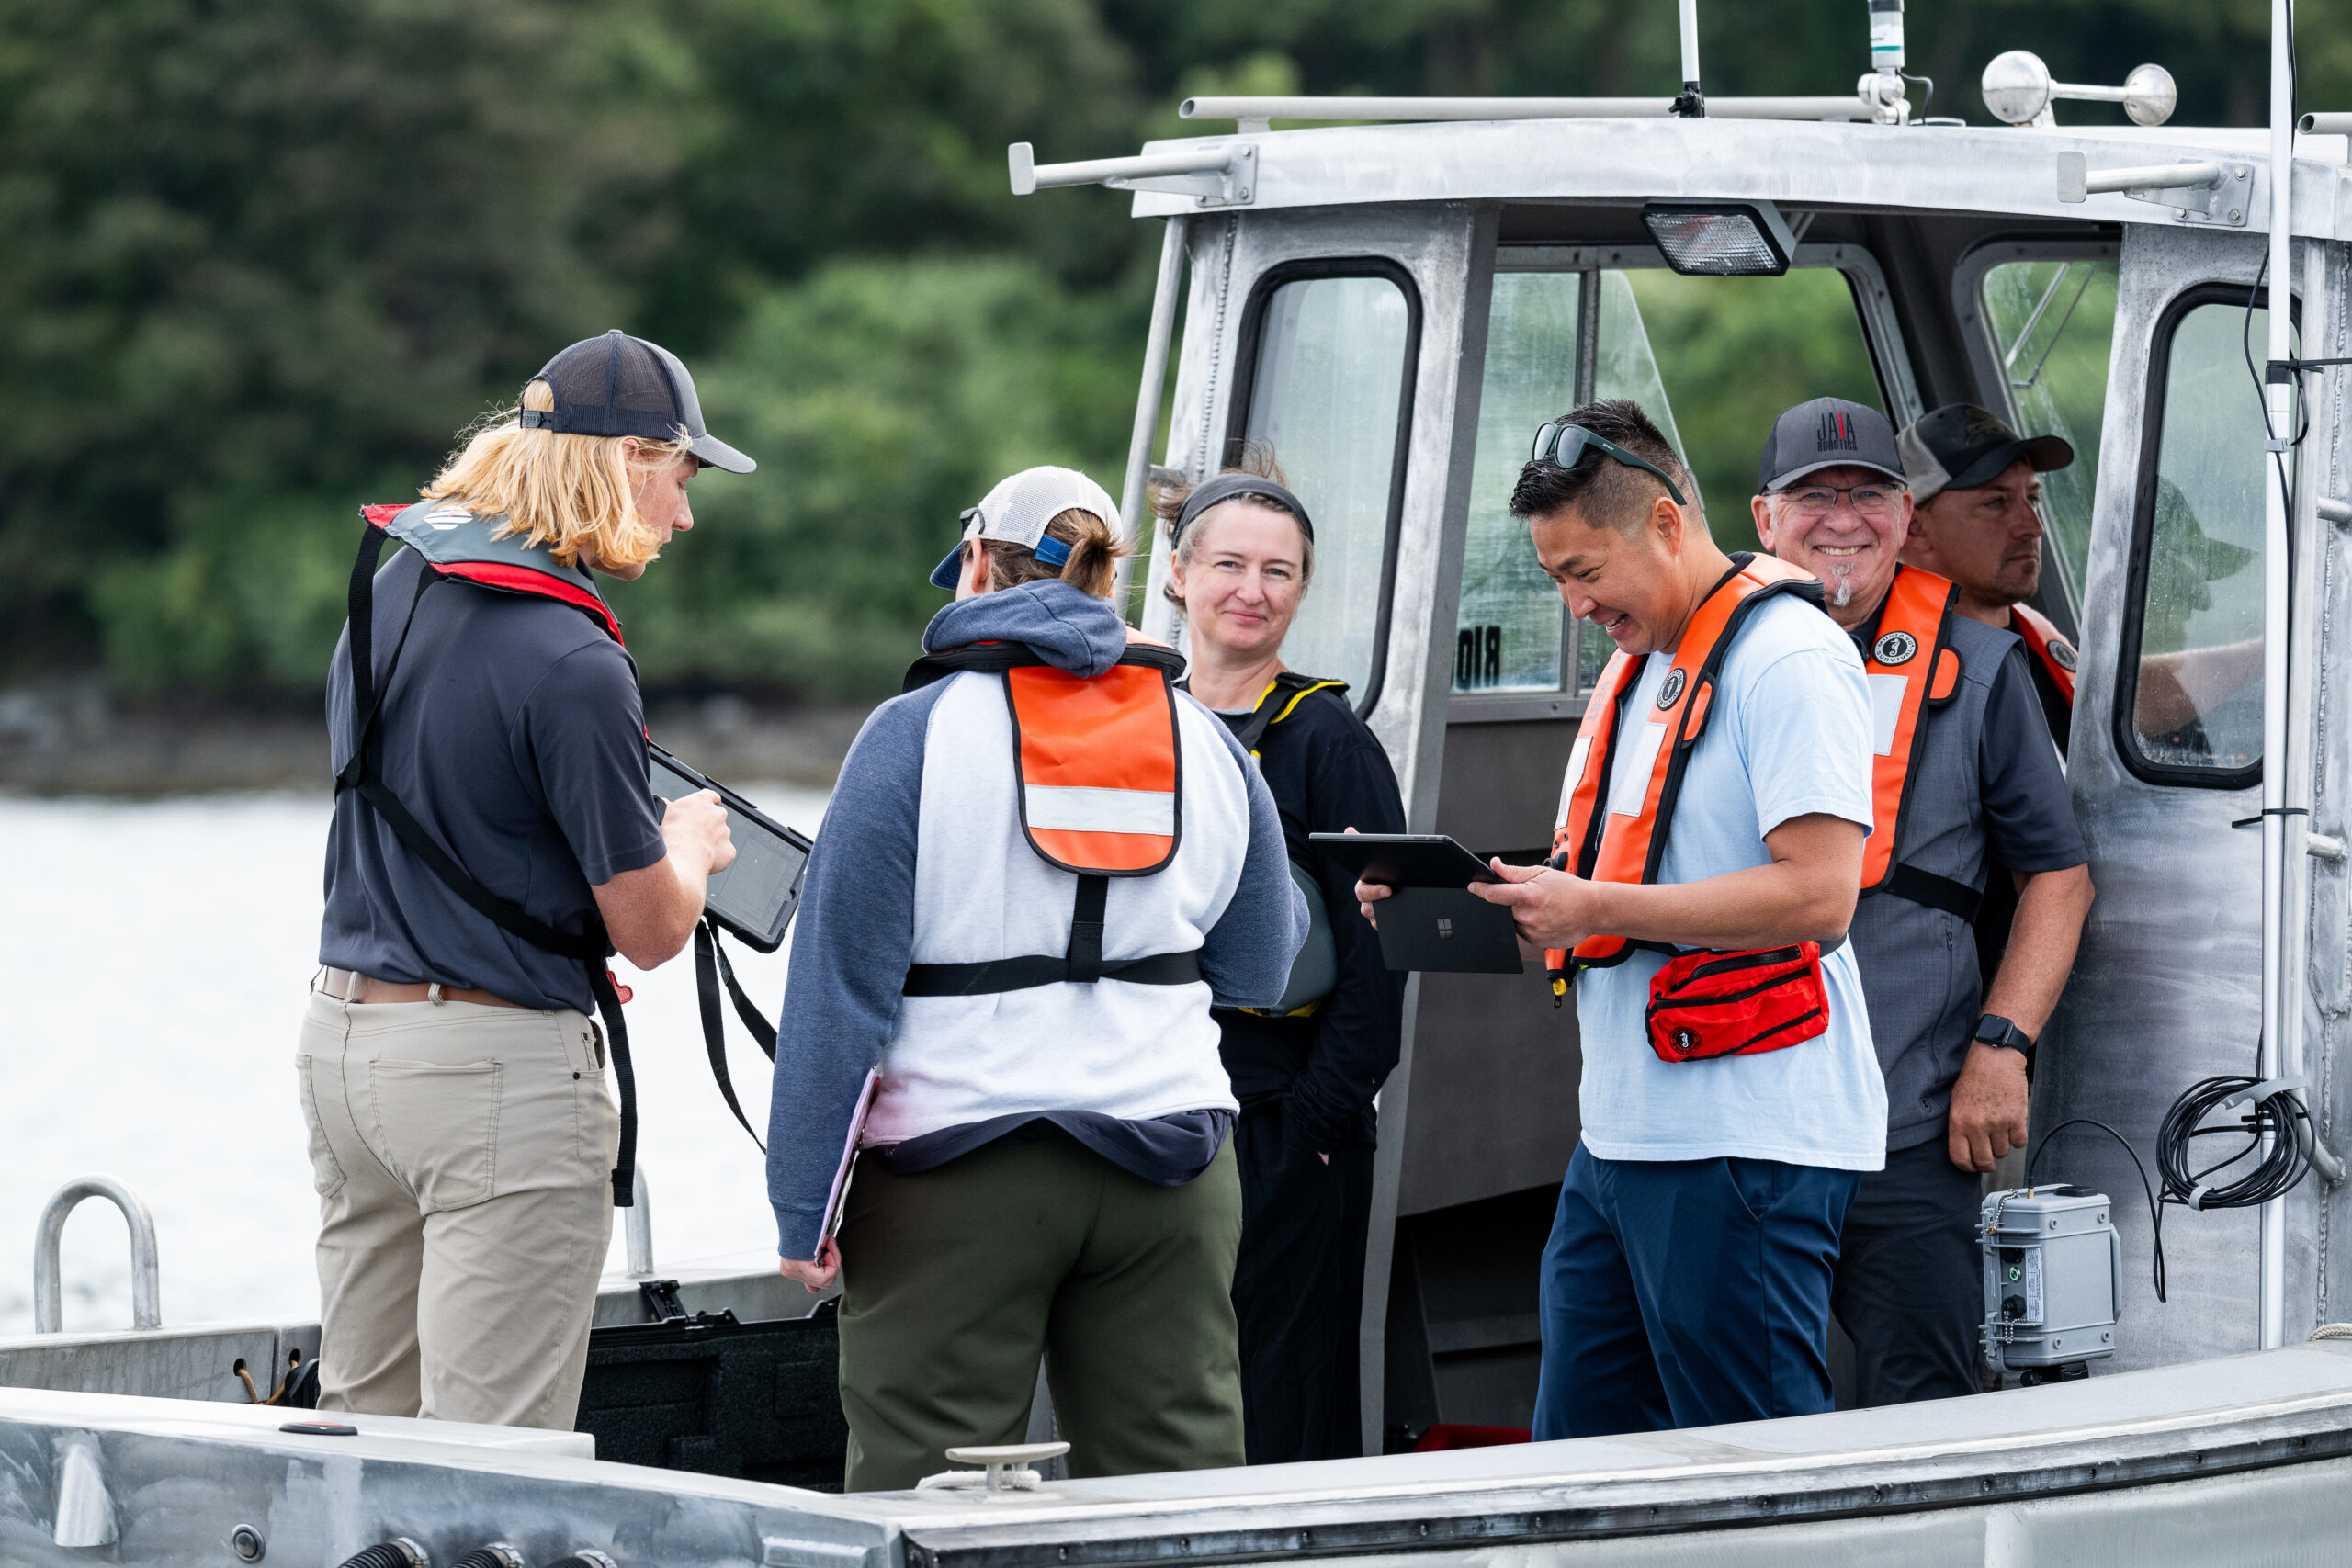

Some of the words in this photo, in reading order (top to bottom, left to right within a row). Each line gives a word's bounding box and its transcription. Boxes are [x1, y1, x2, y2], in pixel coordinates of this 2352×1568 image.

[1817, 412, 1856, 441] JAIA
[1878, 633, 1915, 647] MUSTANG
[1876, 649, 1913, 662] SURVIVAL
